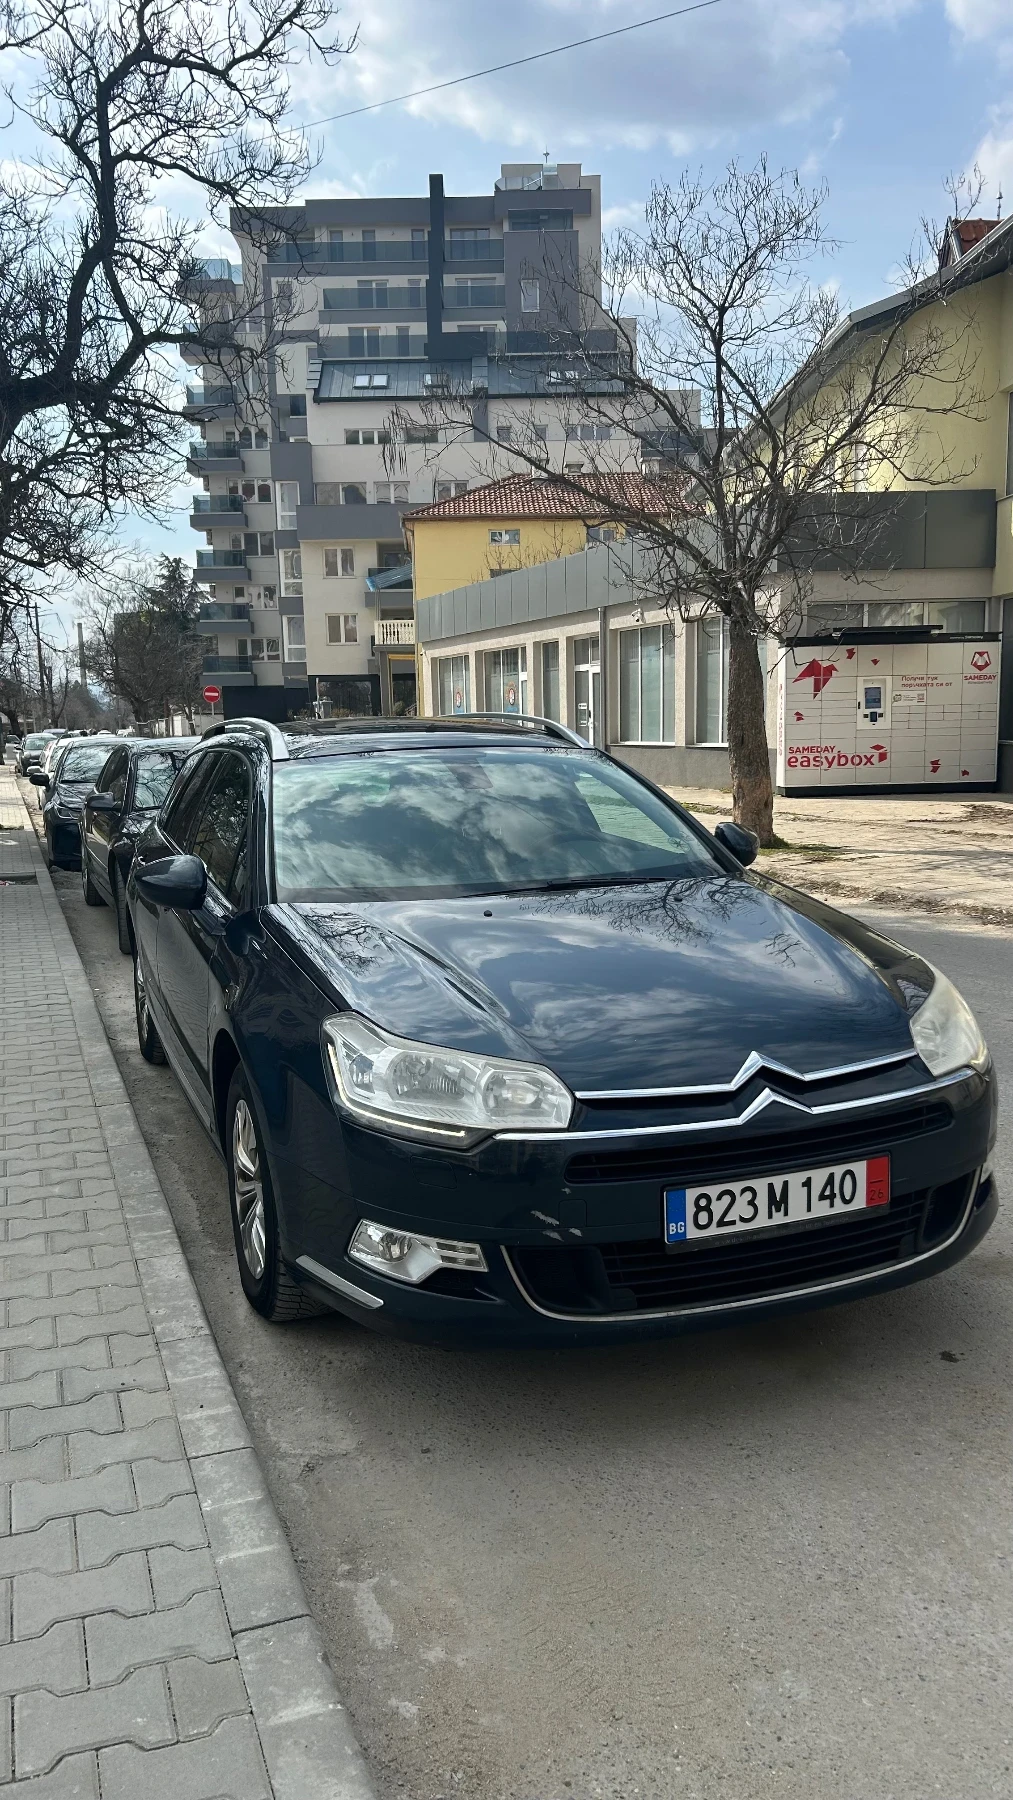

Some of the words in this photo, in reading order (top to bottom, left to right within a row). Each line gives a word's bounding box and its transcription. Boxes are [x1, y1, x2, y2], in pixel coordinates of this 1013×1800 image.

[788, 745, 836, 754] SAMEDAY
[787, 750, 875, 771] easybox
[692, 1186, 758, 1231] 823
[767, 1179, 789, 1220] M
[802, 1168, 857, 1213] 140
[869, 1188, 884, 1201] 26
[669, 1221, 685, 1235] BG
